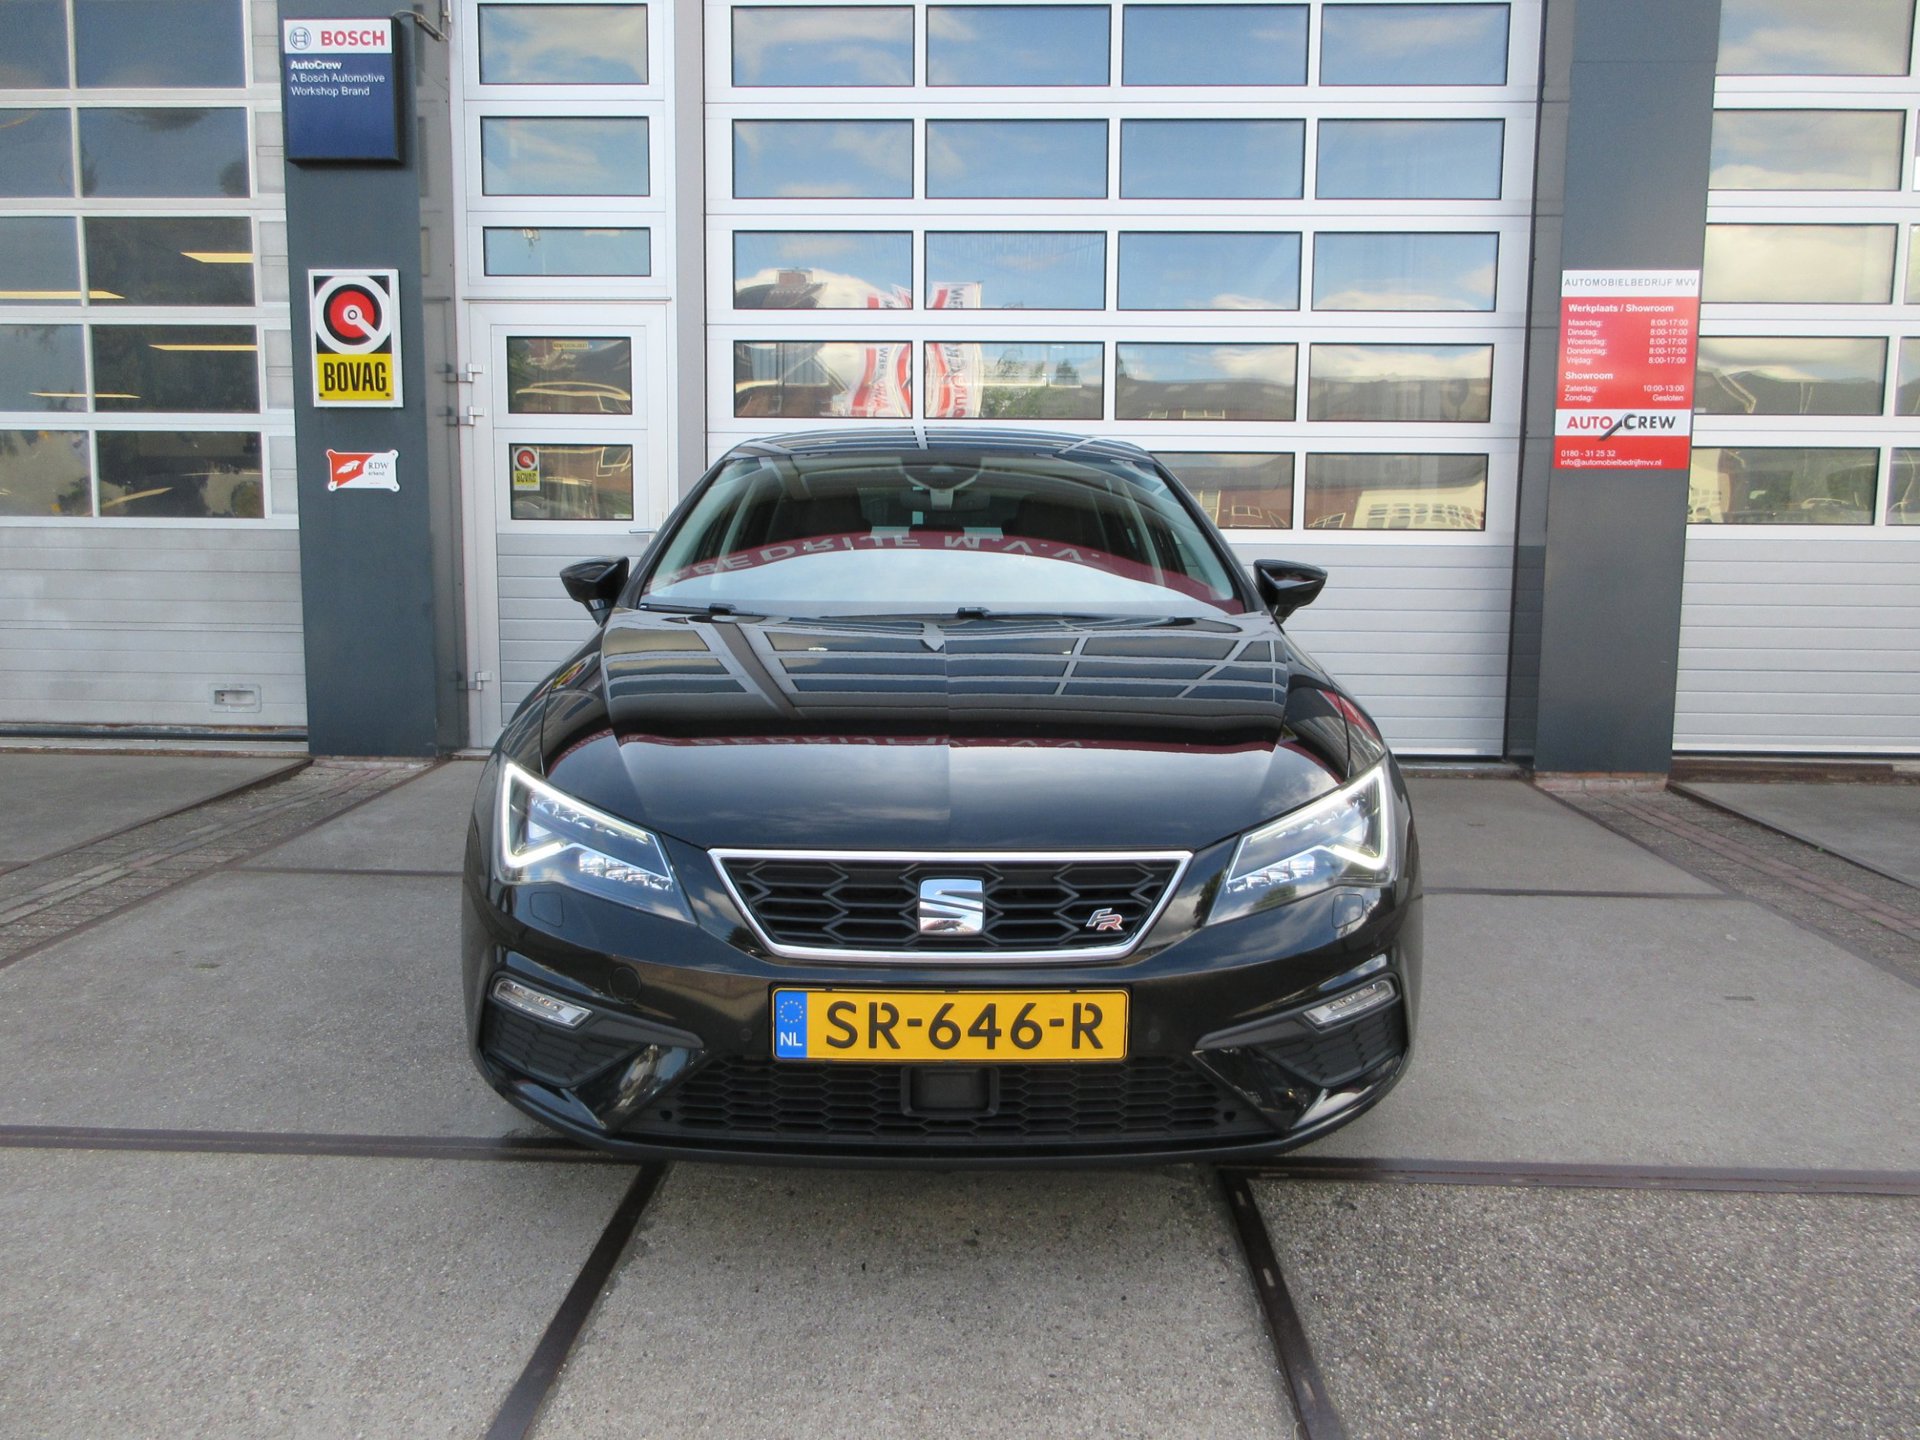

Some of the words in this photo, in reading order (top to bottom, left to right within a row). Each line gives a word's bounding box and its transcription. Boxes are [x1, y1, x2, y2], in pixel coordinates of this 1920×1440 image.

[320, 31, 385, 46] BOSCH
[290, 60, 342, 70] AutoCrew
[290, 74, 299, 83] A
[300, 73, 330, 83] Bosch
[332, 73, 386, 83] Automotive
[291, 87, 339, 97] Workshop
[341, 87, 370, 96] Brand
[1564, 278, 1672, 287] AUTOMOBIELBEDRIJF
[1675, 278, 1697, 287] MVV
[1568, 304, 1618, 313] Werkplaats
[1619, 304, 1624, 312] /
[1625, 304, 1674, 312] Showroom
[1568, 319, 1603, 327] Maandag:
[1567, 328, 1598, 337] Dinsdag:
[1567, 338, 1607, 346] Woensdag:
[323, 361, 386, 392] BOVAG
[1564, 371, 1613, 380] Showroom
[1564, 384, 1598, 393] Zaterdag:
[1643, 384, 1685, 392] 10:00-13:00
[1564, 394, 1593, 402] Zondag:
[1567, 416, 1613, 430] AUTO
[1623, 413, 1676, 430] CREW
[1560, 459, 1662, 467] info@automobielbedrijfmvv.nl
[1085, 907, 1124, 931] FR
[825, 1000, 1104, 1050] SR-646-R
[780, 1032, 803, 1047] NL
